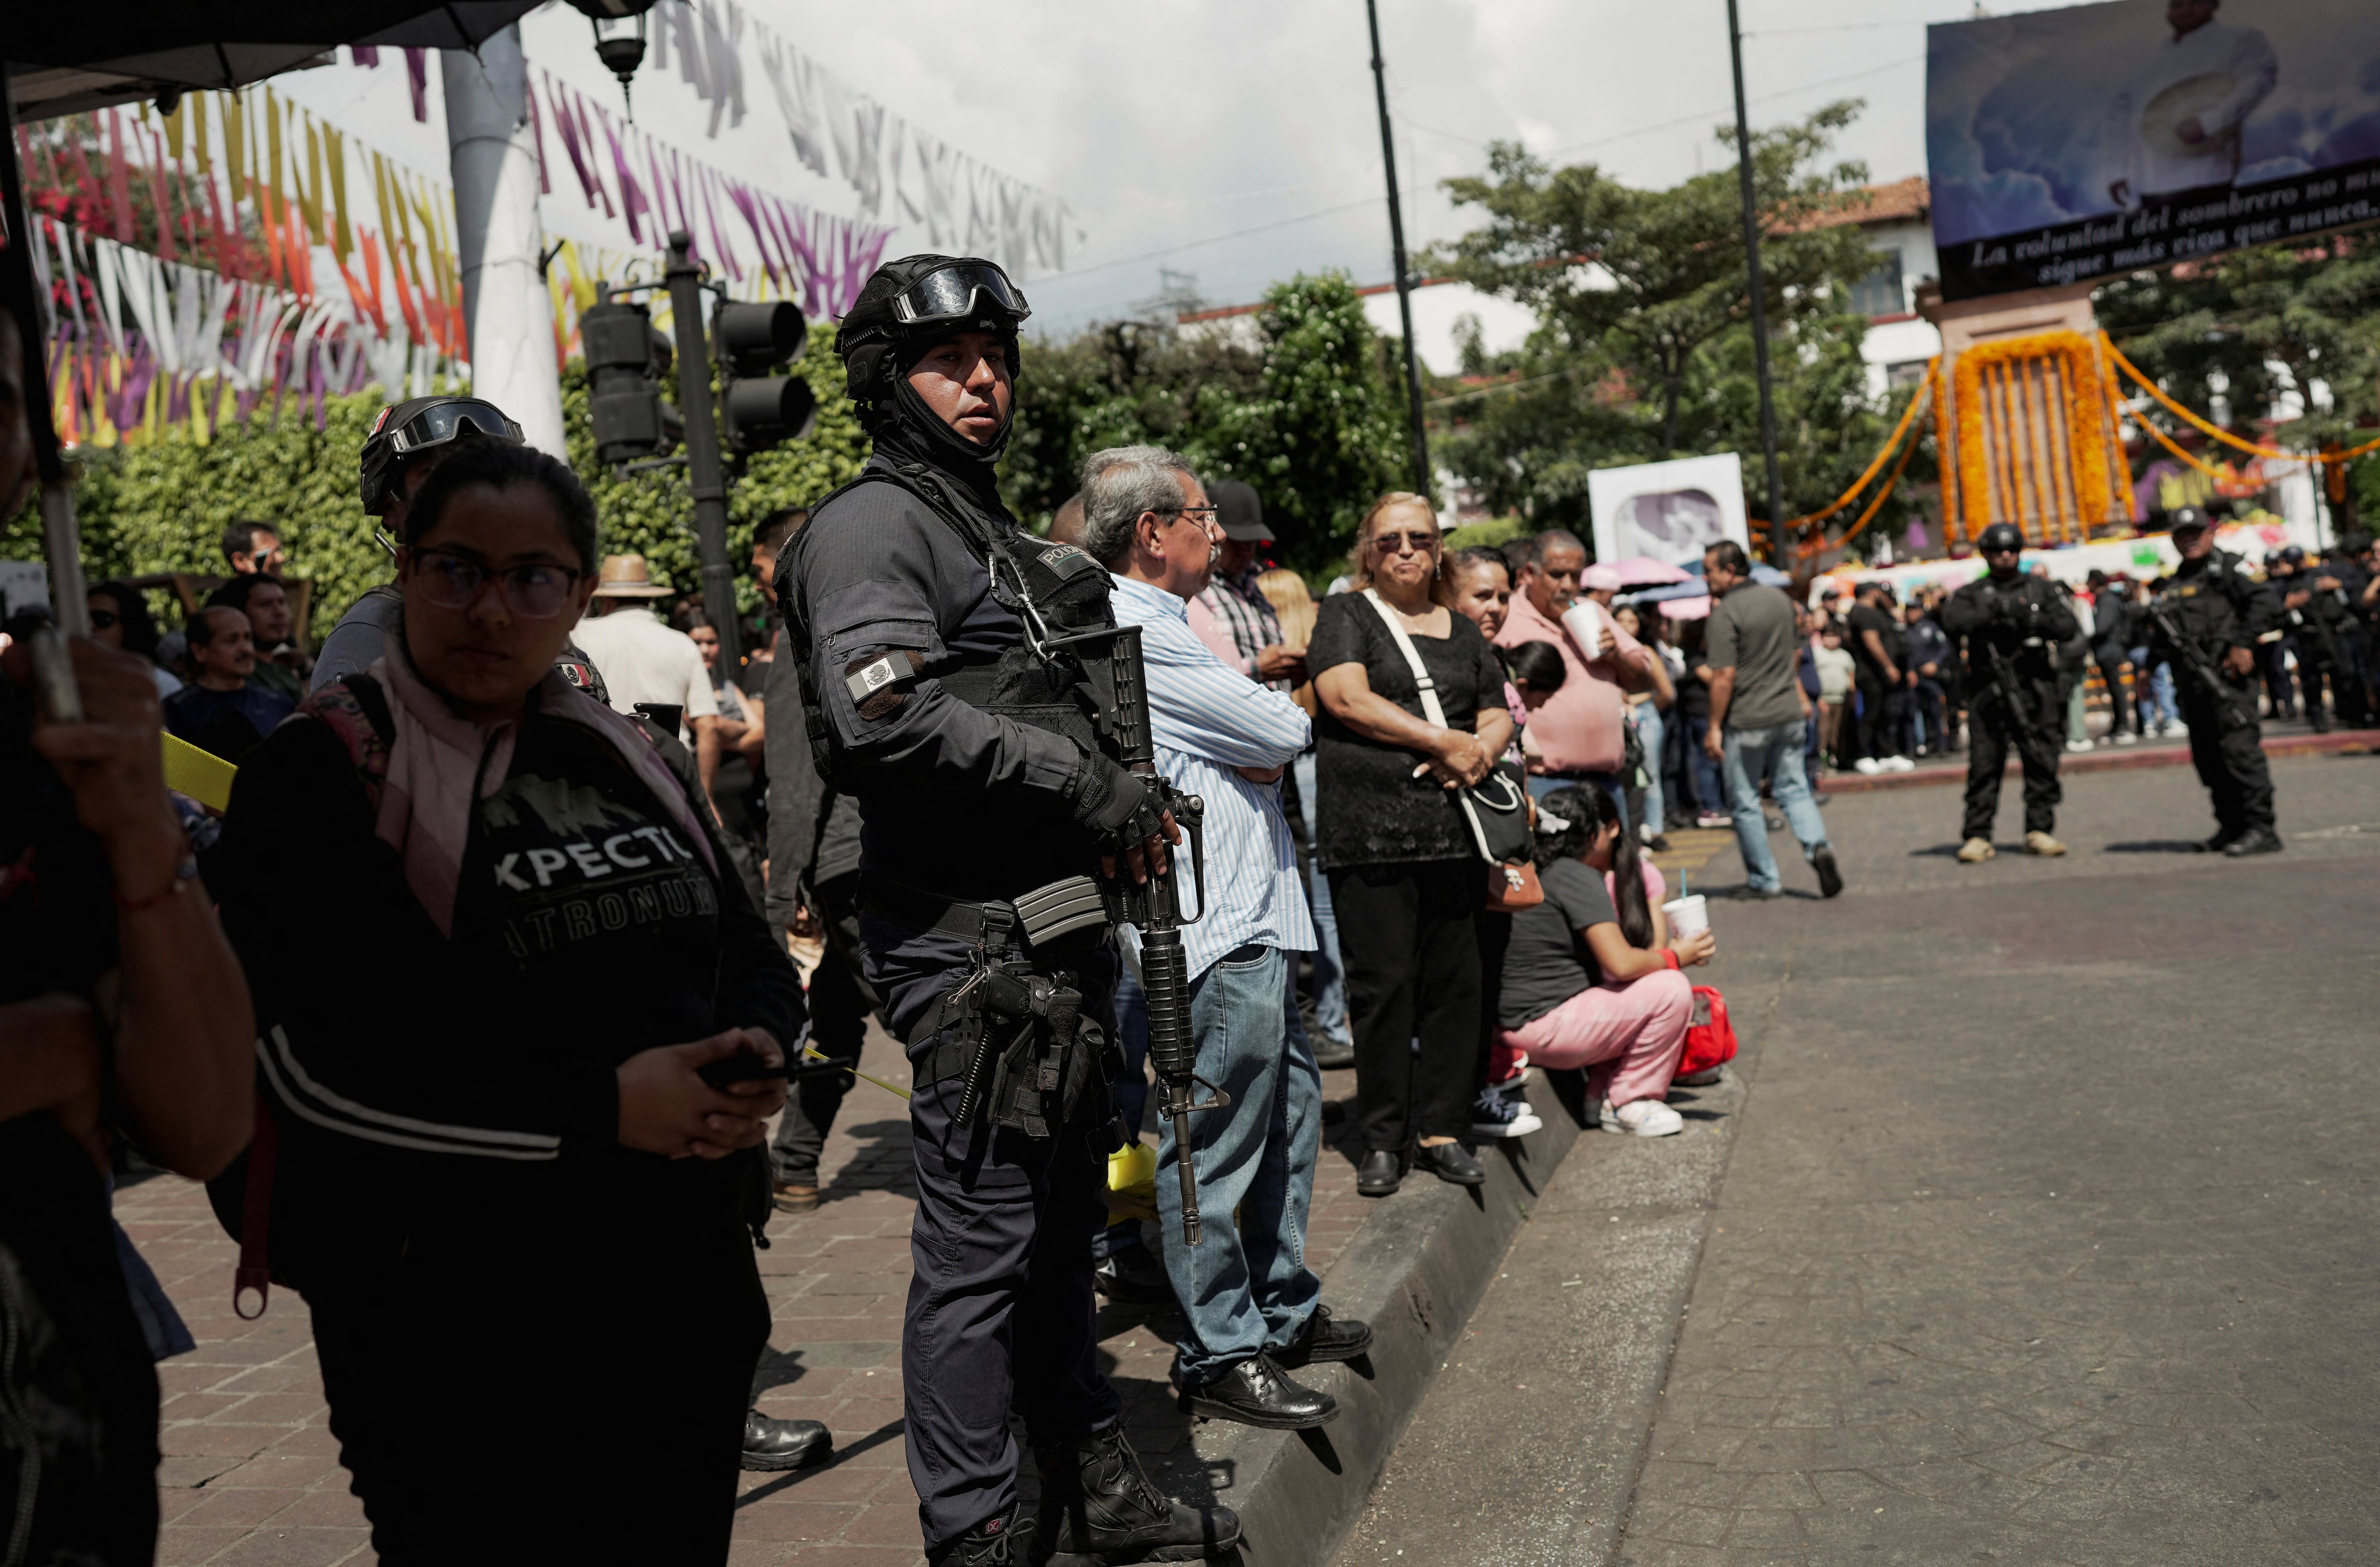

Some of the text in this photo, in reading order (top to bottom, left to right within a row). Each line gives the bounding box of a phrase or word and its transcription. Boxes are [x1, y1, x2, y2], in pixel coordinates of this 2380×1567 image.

[1973, 241, 2007, 268] La
[2015, 214, 2125, 260] voluntad
[2132, 205, 2171, 237] del
[2176, 188, 2299, 227] sombrero
[2305, 178, 2338, 201] no
[2038, 255, 2106, 286] sigue
[2173, 228, 2226, 256] viva
[2233, 217, 2282, 248] que
